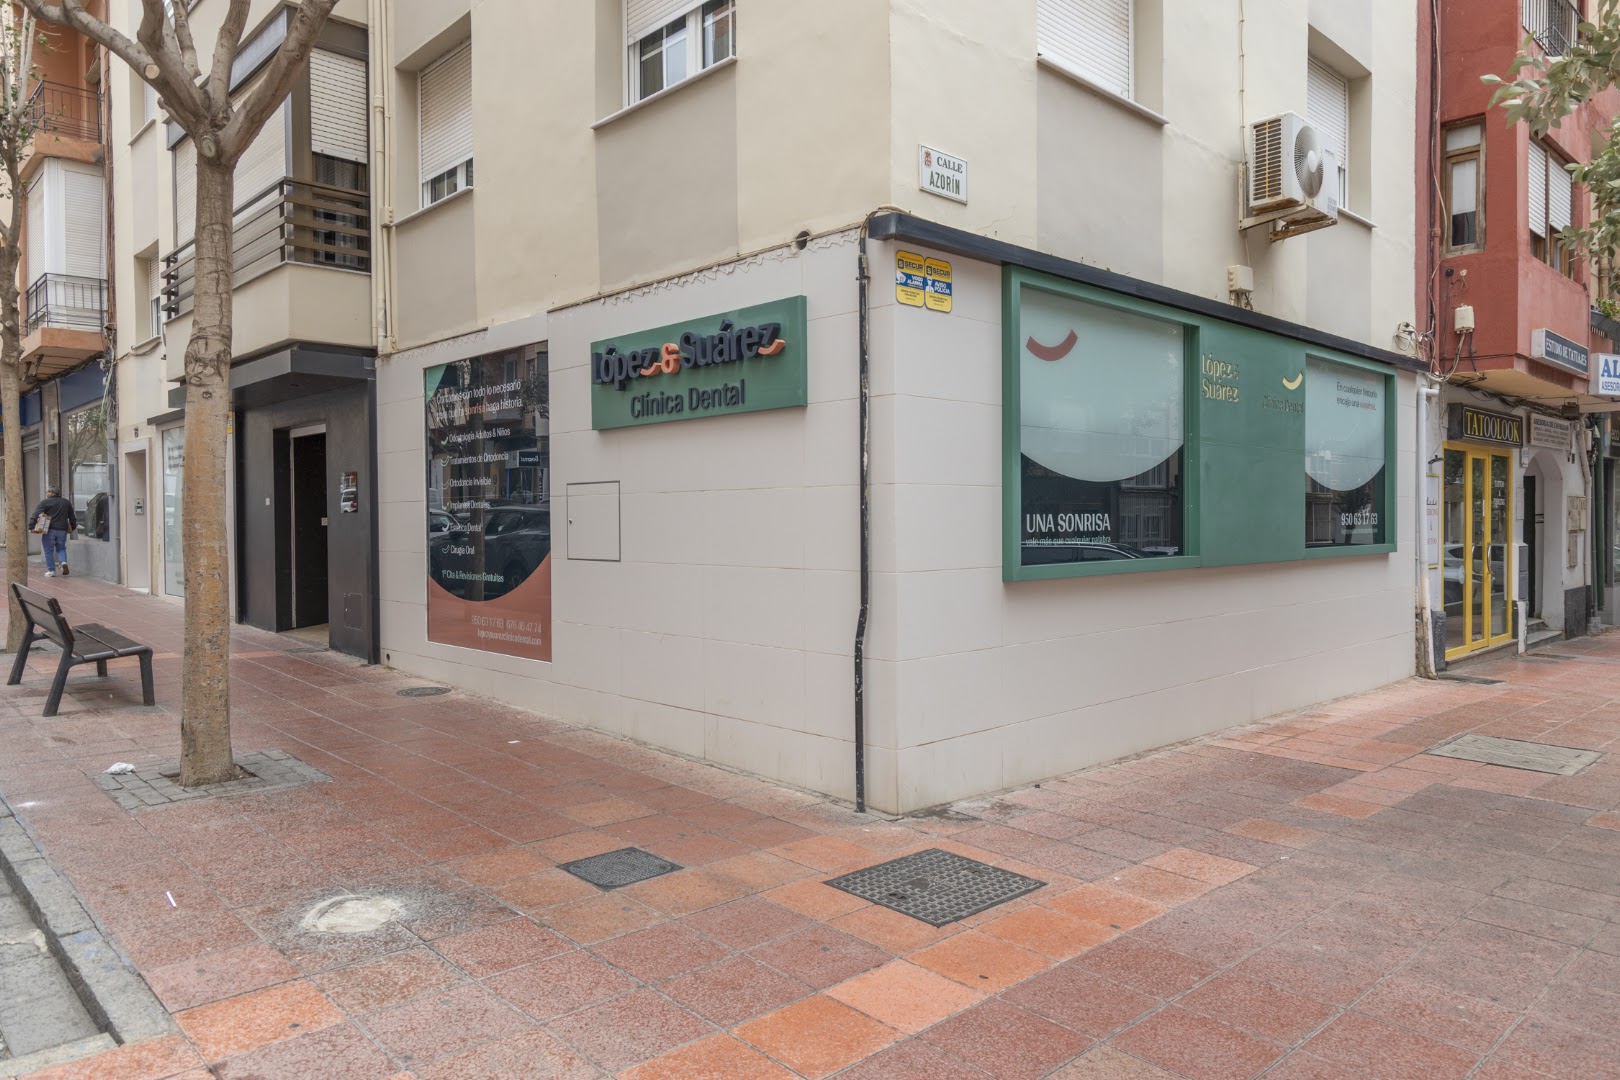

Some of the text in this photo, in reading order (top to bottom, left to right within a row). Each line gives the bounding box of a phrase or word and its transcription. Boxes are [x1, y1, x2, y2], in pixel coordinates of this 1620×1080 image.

[936, 156, 963, 174] CALLE
[929, 171, 960, 195] AZORÍN
[592, 318, 786, 391] López & Suárez
[1546, 337, 1562, 356] ESTUDIO
[1562, 345, 1568, 358] DE
[1202, 352, 1233, 381] López
[473, 386, 485, 398] todo
[486, 384, 493, 395] lo
[493, 380, 521, 394] necesario
[1202, 377, 1239, 402] Suárez
[630, 378, 746, 419] Clínica Dental
[465, 403, 486, 416] sonrisa
[1465, 411, 1520, 442] TATOOLOOK
[484, 452, 509, 462] Ortodoncia
[471, 500, 491, 509] Dentales
[467, 522, 482, 532] Dental
[1026, 512, 1111, 533] UNA SONRISA
[1341, 512, 1378, 526] 950 63 17 63
[466, 545, 475, 555] Oral
[482, 572, 504, 583] Gratuitas
